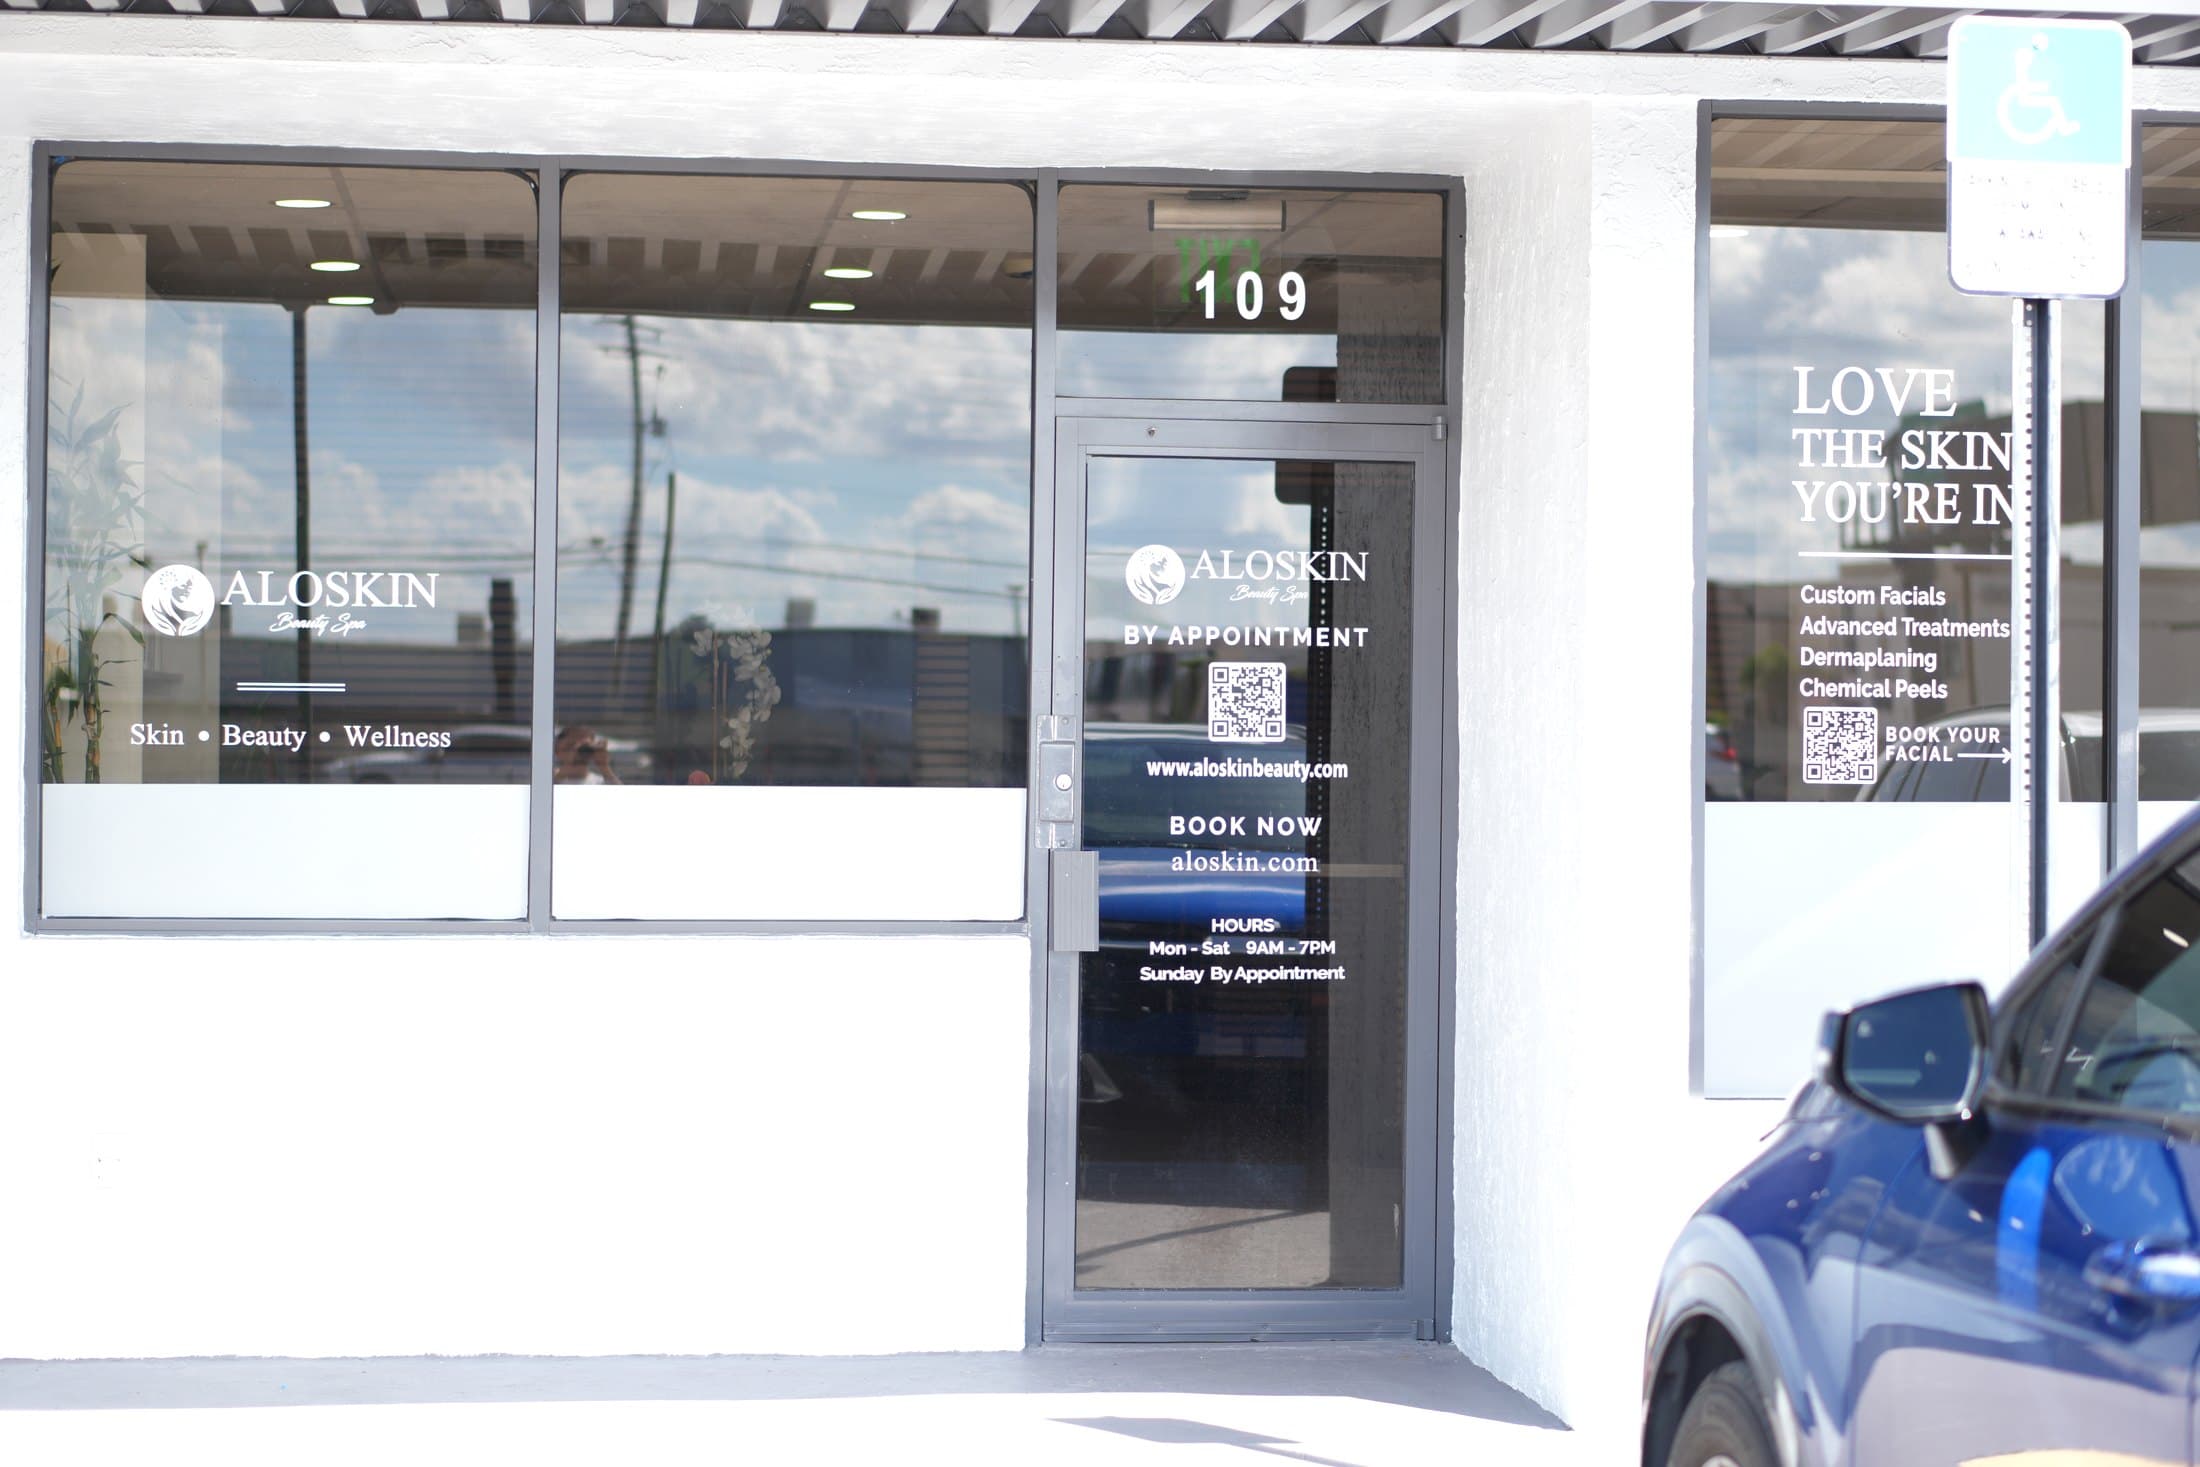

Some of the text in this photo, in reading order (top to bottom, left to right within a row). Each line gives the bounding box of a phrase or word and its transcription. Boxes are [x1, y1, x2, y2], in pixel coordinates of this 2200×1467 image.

[1195, 270, 1306, 320] 109
[1792, 366, 1957, 417] LOVE
[1792, 428, 2013, 471] THE SKIN
[1190, 550, 1369, 582] ALOSKIN
[220, 570, 440, 609] ALOSKIN
[1230, 584, 1309, 605] Beauty Spa
[1800, 584, 1946, 606] Custom Facials
[269, 612, 367, 637] Beauty Spa
[1800, 616, 2011, 638] Advanced Treatments
[1124, 625, 1369, 647] BY APPOINTMENT
[1800, 647, 1937, 672] Dermaplaning
[1800, 678, 1948, 699] Chemical Peels
[130, 723, 185, 745] Skin
[222, 724, 307, 752] Beauty
[343, 725, 451, 748] Wellness
[1885, 726, 2001, 744] BOOK YOUR
[1885, 746, 1954, 762] FACIAL
[1147, 757, 1348, 783] www.aloskinbeauty.com
[1169, 816, 1322, 836] BOOK NOW
[1171, 850, 1319, 873] aloskin.com
[1211, 918, 1276, 933] HOURS
[1149, 941, 1187, 956] Mon
[1201, 941, 1230, 955] Sat
[1245, 940, 1284, 955] 9AM
[1299, 940, 1336, 955] 7PM
[1139, 966, 1346, 985] Sunday By Appointment
